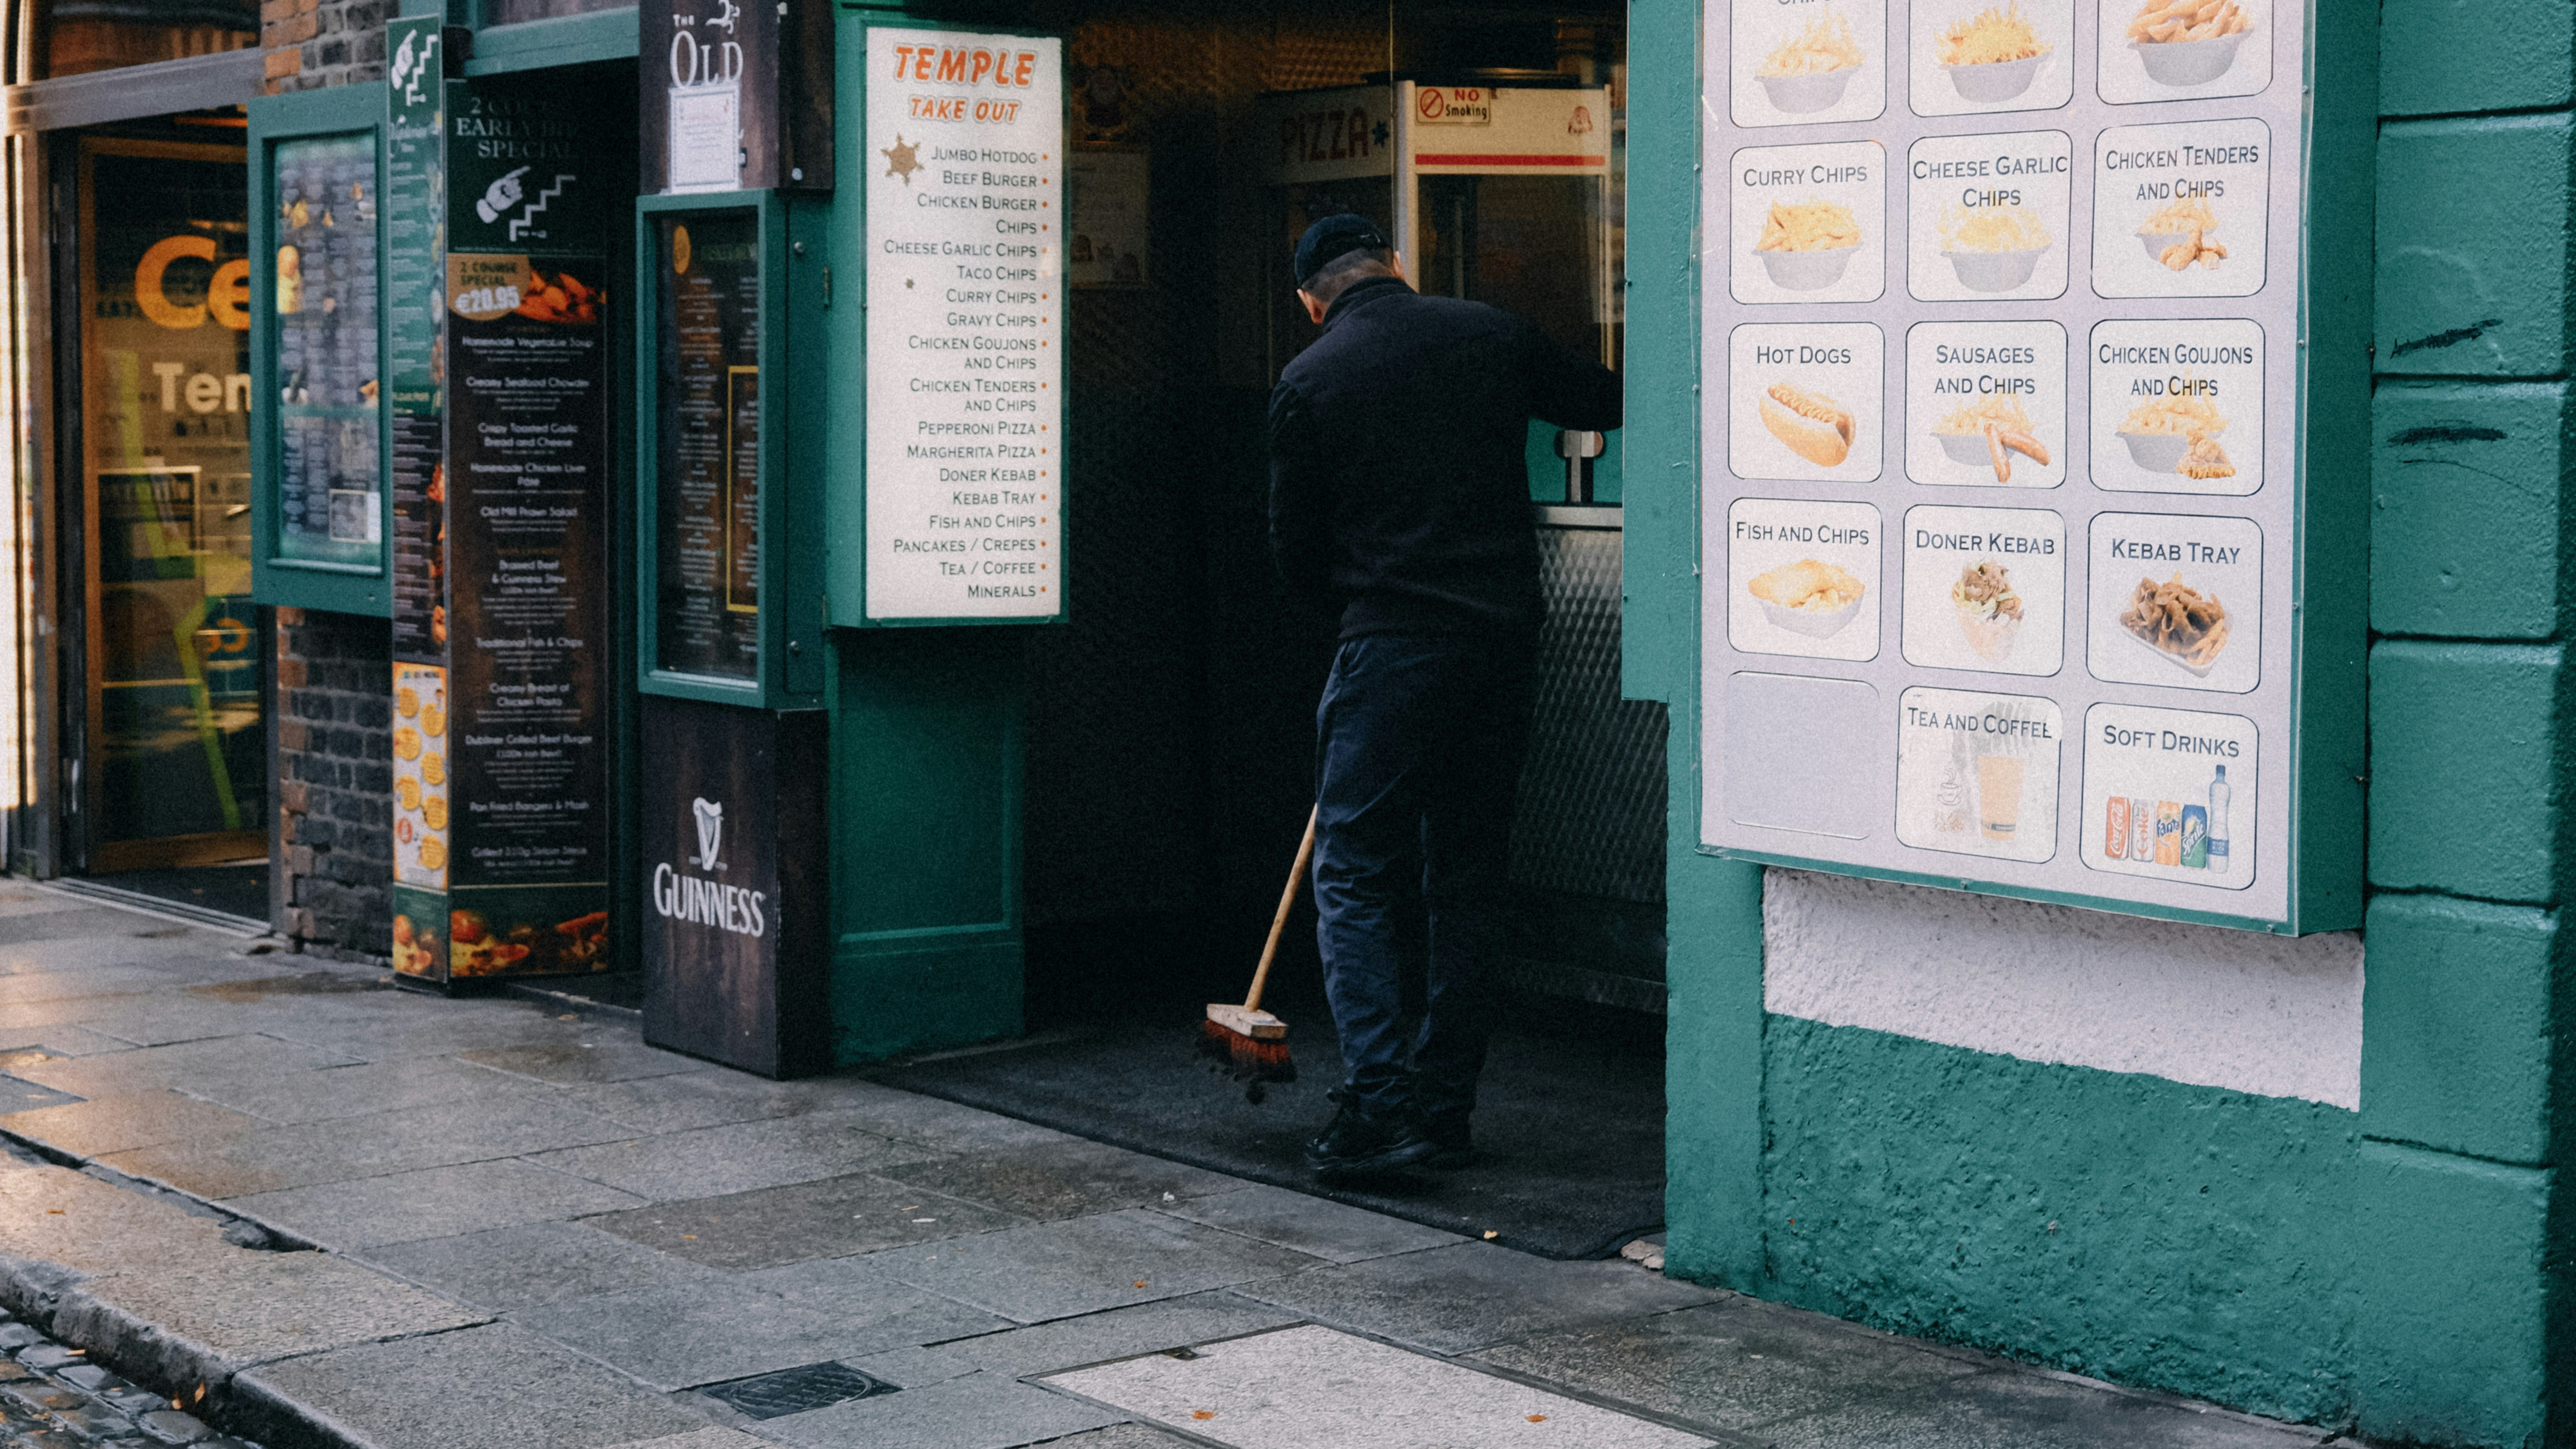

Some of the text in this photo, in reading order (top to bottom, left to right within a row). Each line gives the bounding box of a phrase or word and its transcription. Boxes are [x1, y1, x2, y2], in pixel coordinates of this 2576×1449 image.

[670, 30, 743, 89] OLD
[895, 45, 1036, 86] TEMPLE
[1455, 88, 1479, 102] NO
[911, 98, 1019, 121] TAKE OUT
[1446, 104, 1487, 120] Smoking
[457, 118, 532, 136] EARLY
[1281, 107, 1369, 163] PIZZA
[478, 139, 577, 159] SPECIAL
[931, 146, 1037, 164] JUMBO HOTDOG
[2107, 146, 2258, 170] CHICKEN TENDERS
[1744, 166, 1867, 186] CURRY CHIPS
[1913, 156, 2067, 179] CHEESE GARLIC
[943, 170, 1037, 187] BEEF BURGER
[1962, 188, 2021, 207] CHIPS
[2136, 178, 2224, 201] AND CHIPS
[917, 193, 1037, 211] CHICKEN BURGER
[996, 219, 1037, 234] CHIPS
[884, 239, 1037, 258] CHEESE GARLIC CHIPS
[957, 265, 1037, 281] TACO CHIPS
[946, 289, 1037, 304] CURRY CHIPS
[947, 313, 1037, 327] GRAVY CHIPS
[909, 335, 1036, 350] CHICKEN GOUJONS
[965, 355, 1036, 369] AND CHIPS
[1756, 346, 1851, 365] HOT DOGS
[1936, 344, 2034, 364] SAUSAGES
[2099, 344, 2253, 364] CHICKEN GOUJONS
[910, 379, 1036, 392] CHICKEN TENDERS
[1934, 375, 2035, 394] AND CHIPS
[2131, 376, 2218, 396] AND CHIPS
[965, 398, 1036, 411] AND CHIPS
[919, 421, 1036, 435] PEPPERONI PIZZA
[908, 445, 1036, 458] MARGHERITA PIZZA
[940, 468, 1036, 481] DONER KEBAB
[953, 491, 1036, 504] KEBAB TRAY
[930, 515, 1036, 528] FISH AND CHIPS
[1736, 521, 1870, 545] FISH AND CHIPS
[1916, 530, 2055, 554] DONER KEBAB
[894, 540, 966, 552] PANCAKES
[983, 538, 1036, 551] CREPES
[2112, 538, 2240, 564] KEBAB TRAY
[940, 562, 966, 575] TEA
[983, 561, 1036, 574] COFFEE
[967, 585, 1036, 598] MINERALS
[1908, 707, 1938, 728] TEA
[1944, 714, 1978, 731] AND
[2104, 725, 2239, 758] SOFT DRINKS
[654, 862, 765, 938] GUINNESS
